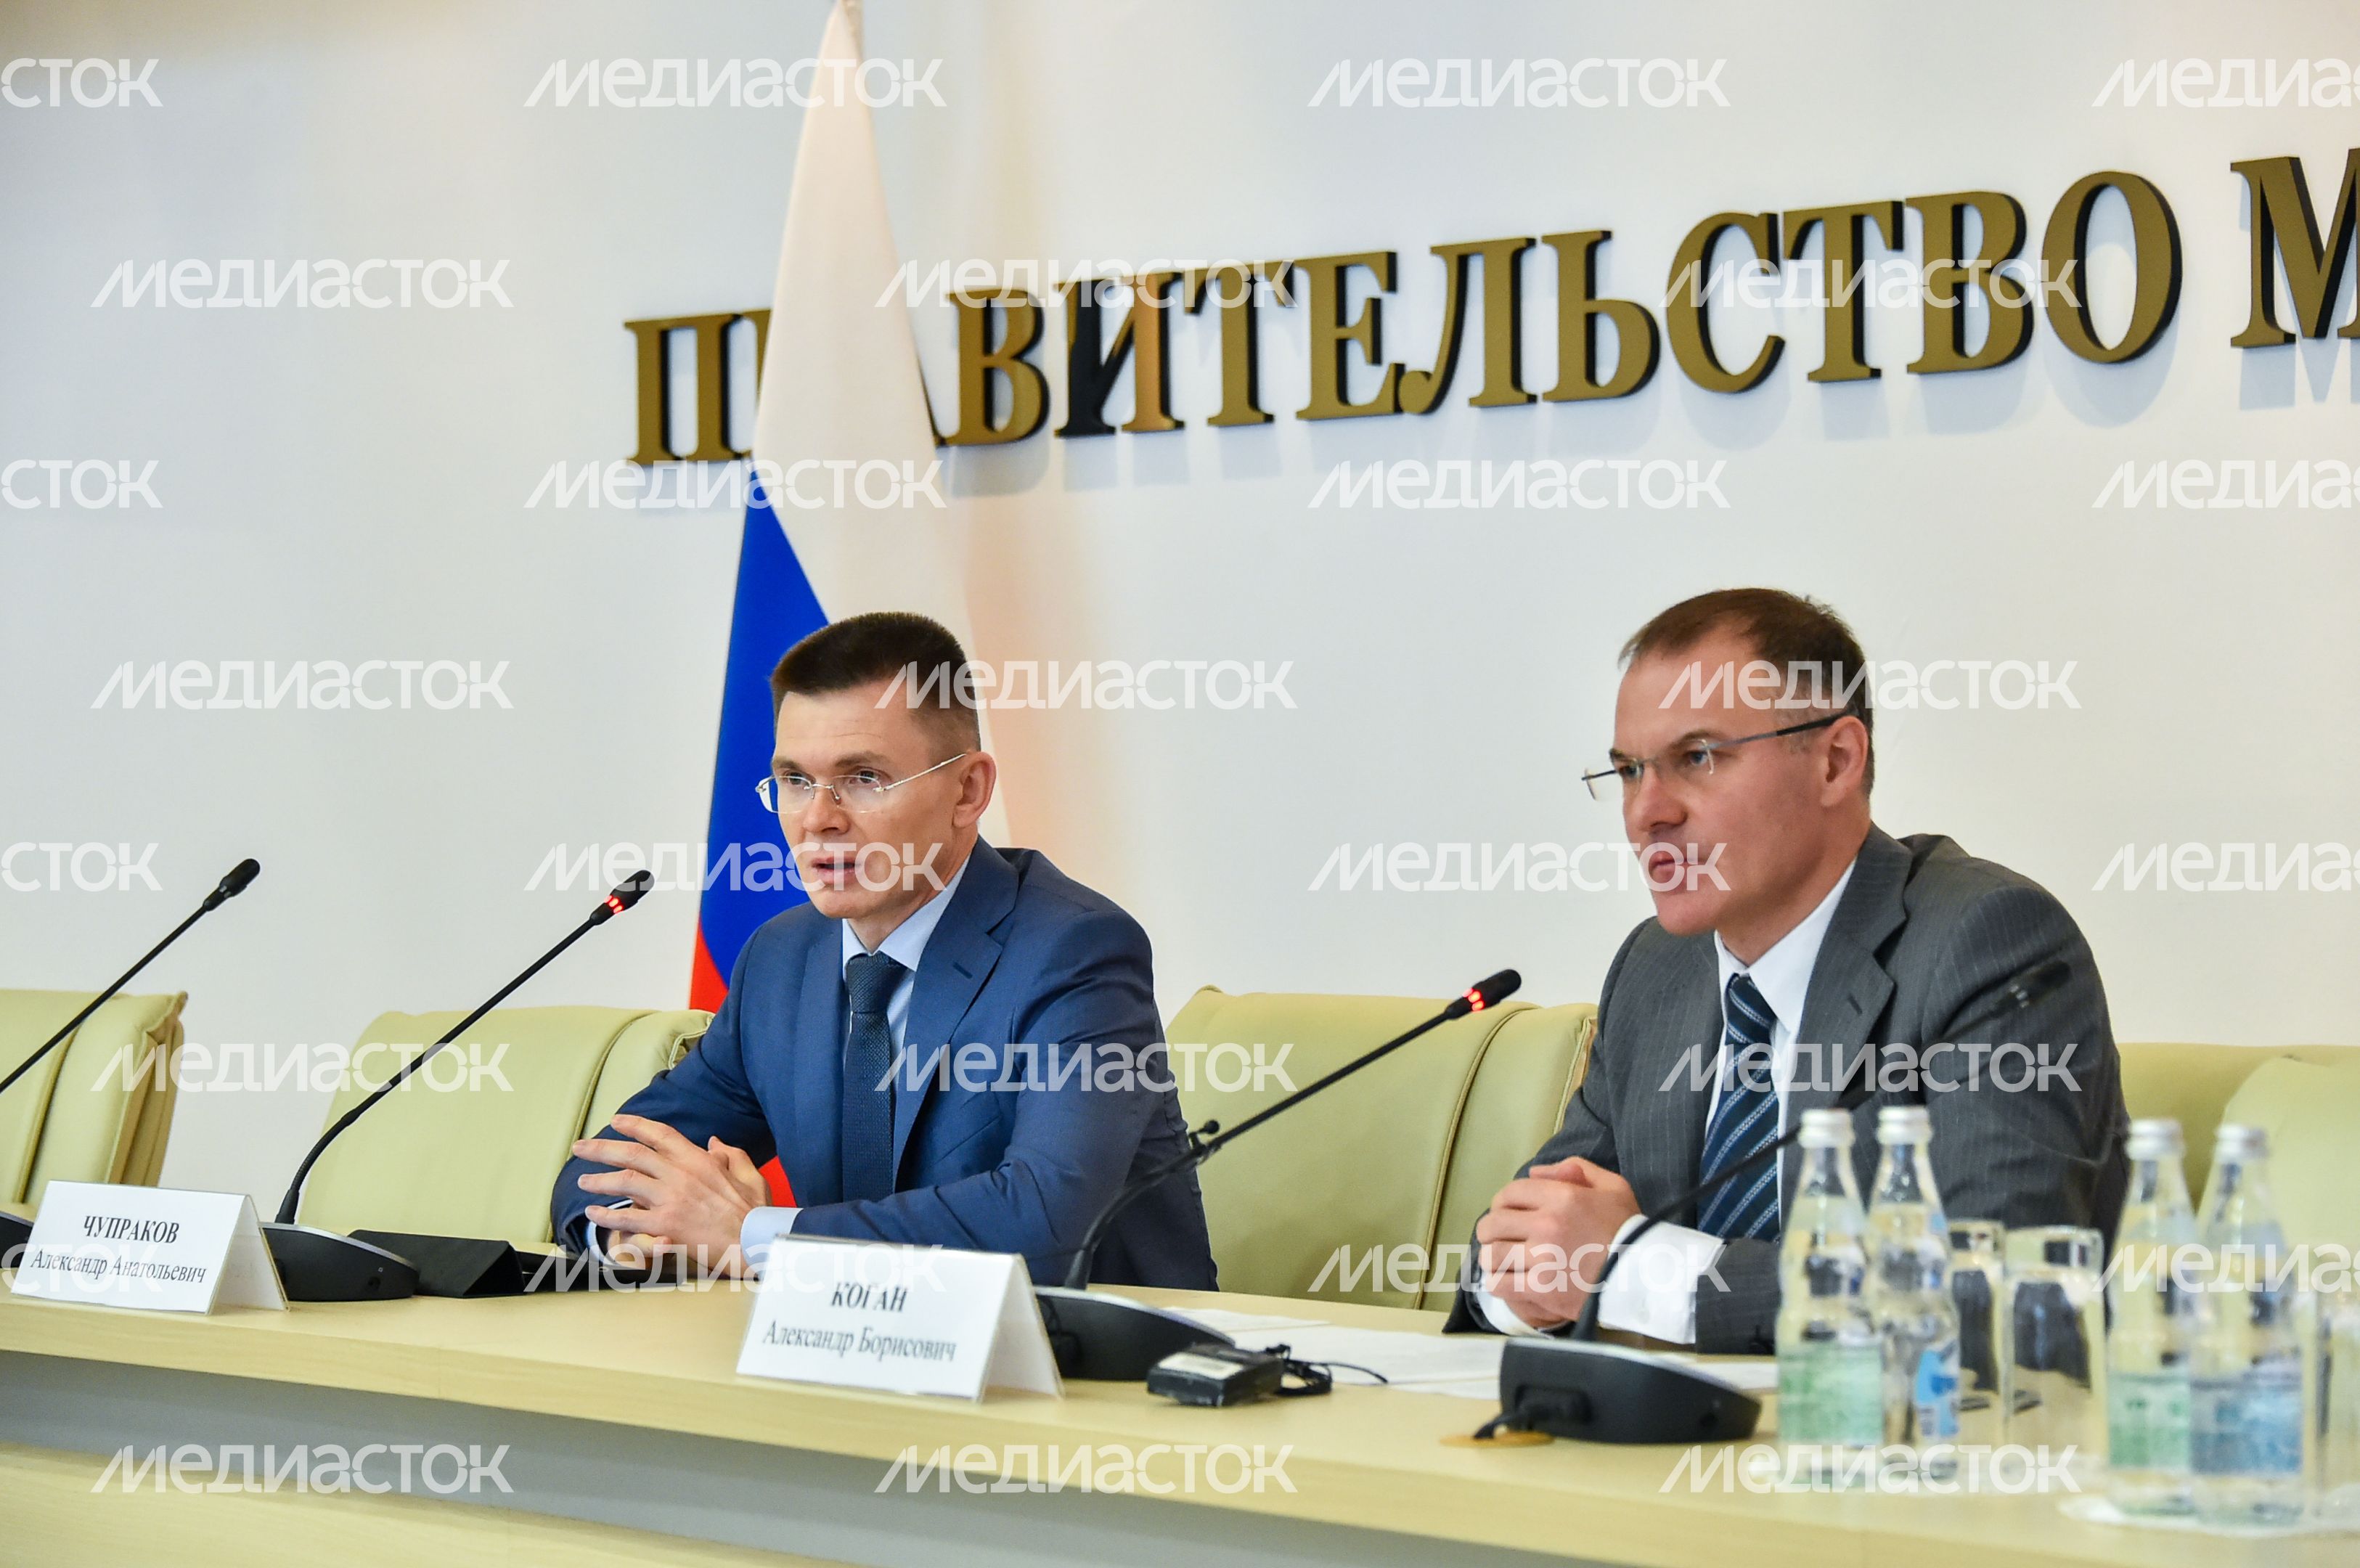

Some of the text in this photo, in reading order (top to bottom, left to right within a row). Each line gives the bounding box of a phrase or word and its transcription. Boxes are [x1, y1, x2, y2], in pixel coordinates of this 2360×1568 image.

[623, 170, 2183, 467] ПВИТЕЛЬСТВО
[83, 1215, 180, 1244] ЧУПРАКОВ
[30, 1249, 207, 1283] Александр Анатольевич
[830, 1281, 907, 1312] КОГАН
[762, 1320, 957, 1362] Александр Борисович
